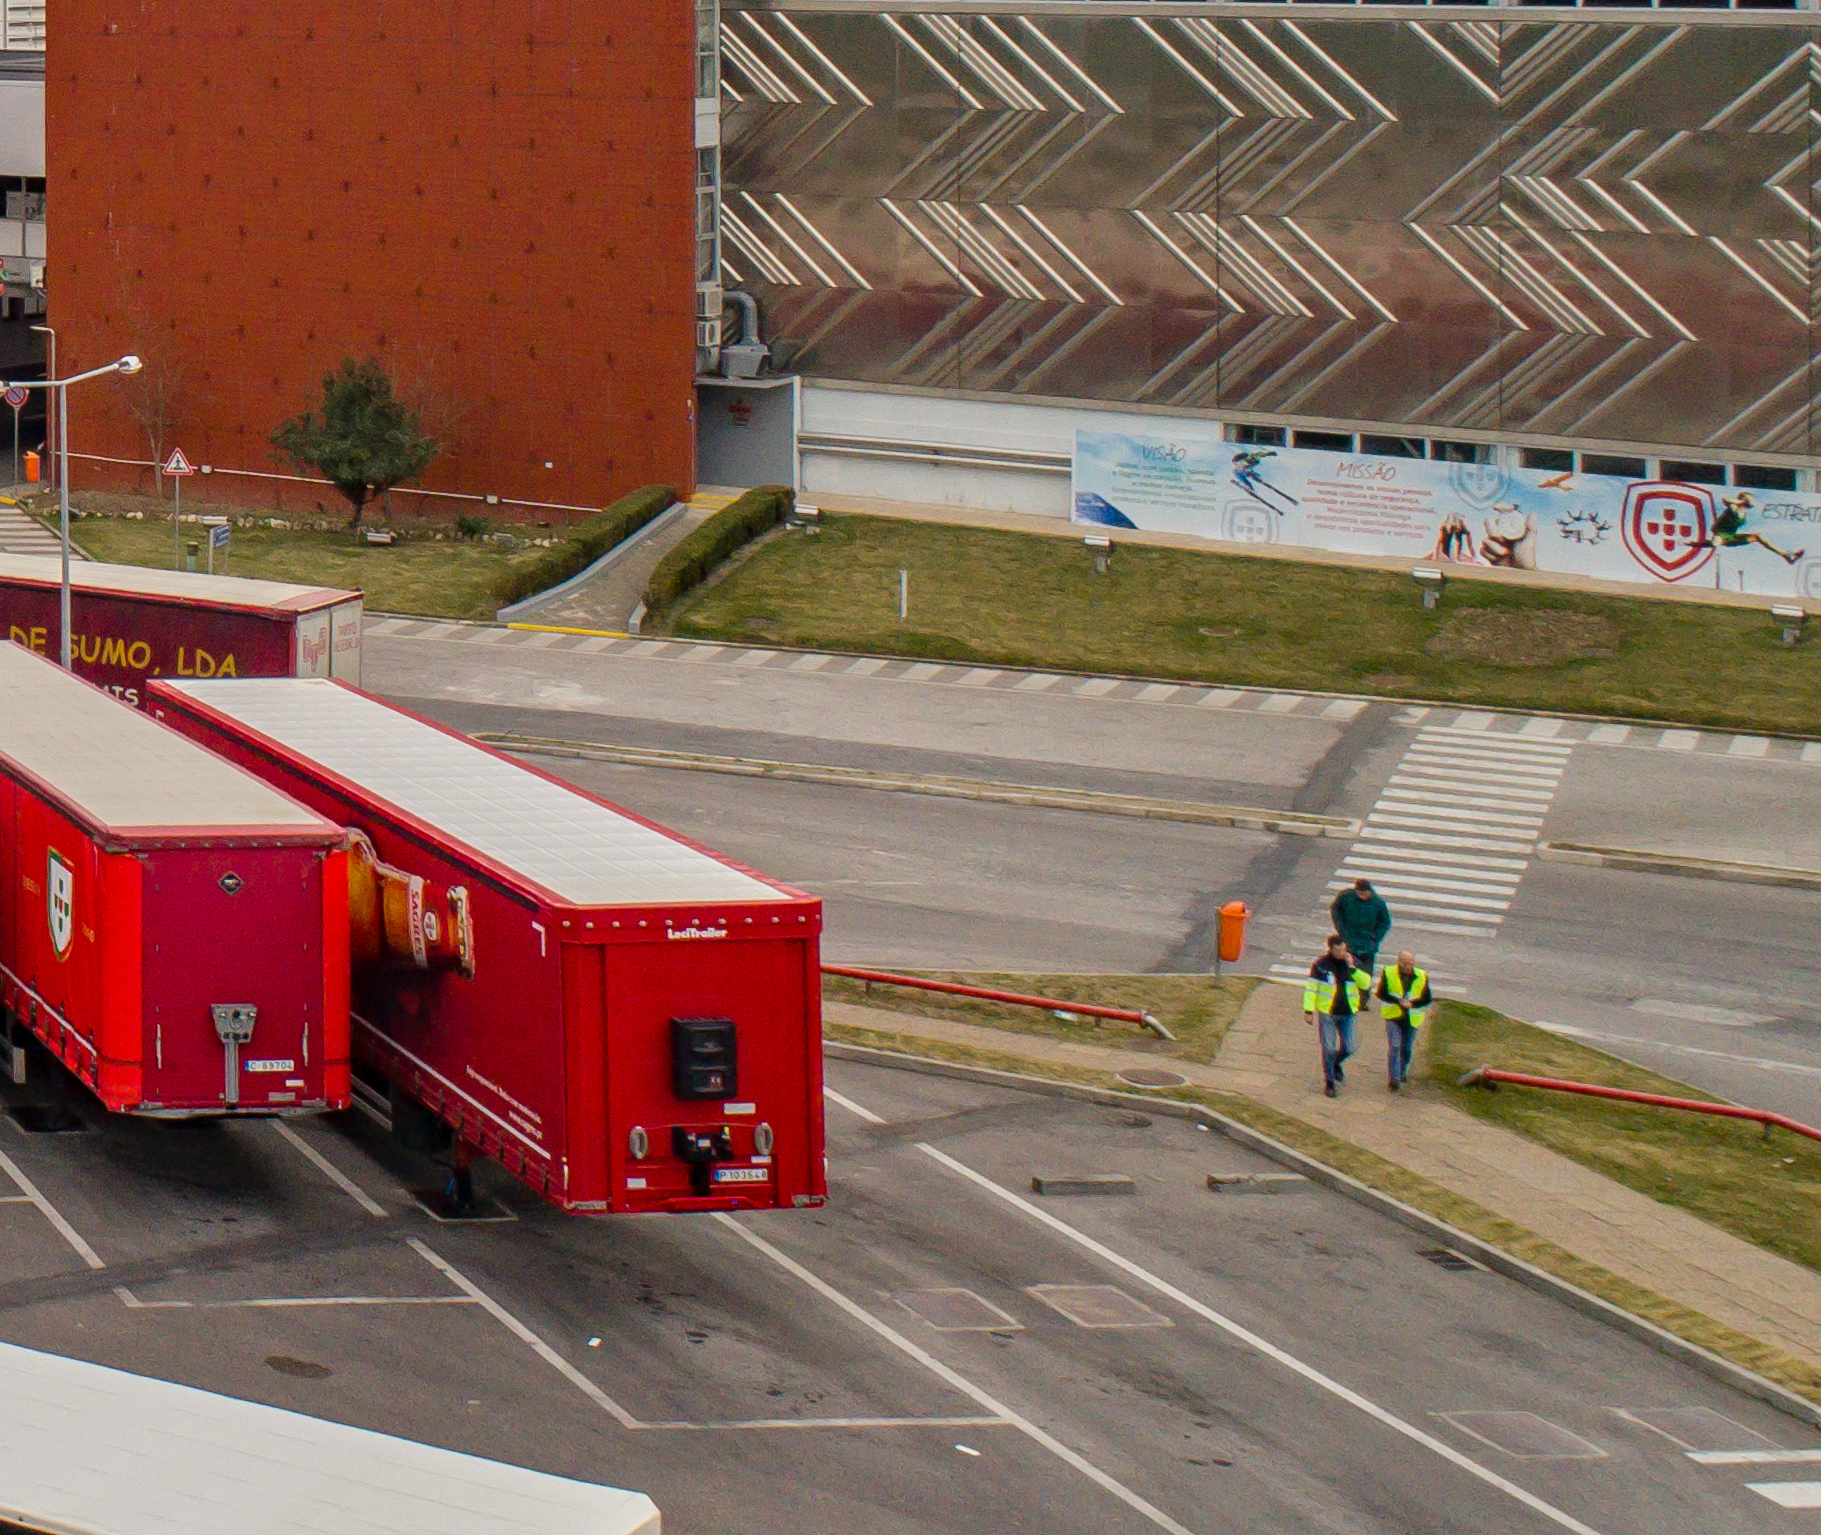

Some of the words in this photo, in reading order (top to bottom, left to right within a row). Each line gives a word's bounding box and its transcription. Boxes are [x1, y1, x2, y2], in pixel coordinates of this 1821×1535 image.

[1141, 444, 1188, 463] VISÃO
[1336, 460, 1397, 482] MISSÃO
[9, 625, 47, 657] DE
[177, 645, 238, 678] LDA
